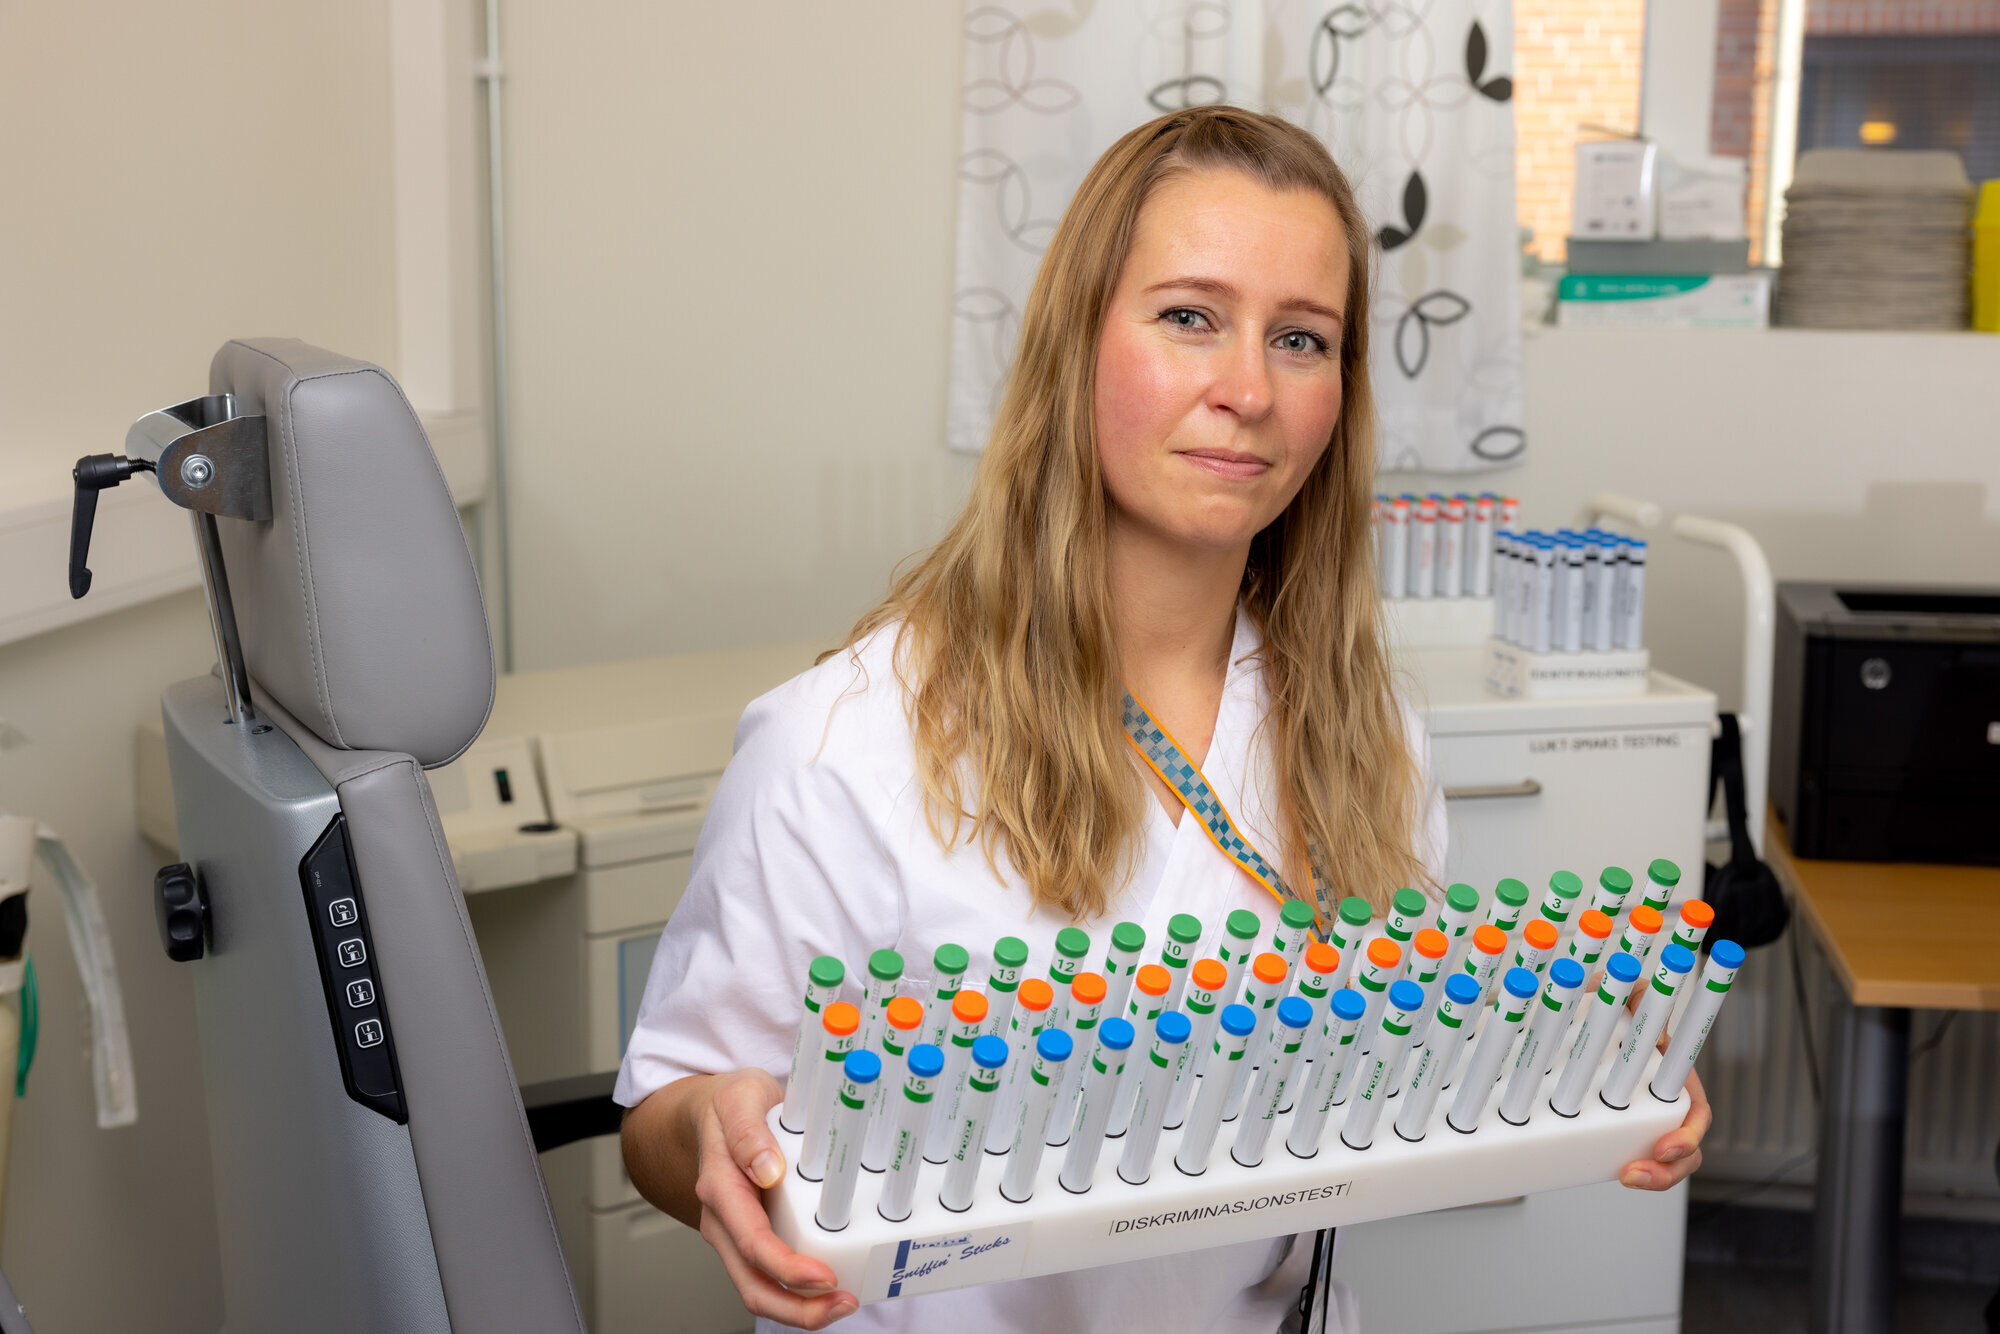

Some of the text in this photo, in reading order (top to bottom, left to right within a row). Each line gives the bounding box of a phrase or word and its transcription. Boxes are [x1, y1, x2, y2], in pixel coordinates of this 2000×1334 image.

[1661, 889, 1669, 899] 1
[1552, 898, 1562, 909] 3
[1394, 917, 1404, 928] 6
[1687, 928, 1696, 938] 1
[1167, 941, 1182, 956] 10
[1058, 959, 1075, 972] 12
[998, 969, 1016, 981] 13
[1369, 966, 1379, 977] 7
[1658, 967, 1668, 980] 2
[1727, 972, 1735, 982] 1
[1312, 976, 1322, 986] 8
[1194, 990, 1212, 1003] 10
[1444, 1001, 1453, 1012] 6
[1396, 1012, 1406, 1023] 7
[1636, 1012, 1649, 1035] Sticks
[1701, 1014, 1715, 1034] Sticks
[962, 1025, 980, 1036] 14
[837, 1037, 854, 1050] 16
[977, 1069, 996, 1080] 14
[909, 1076, 927, 1091] 15
[1115, 1183, 1347, 1233] DISKRIMINASJONSTEST
[891, 1253, 951, 1284] Sniffin'
[960, 1236, 1011, 1260] Sticks
